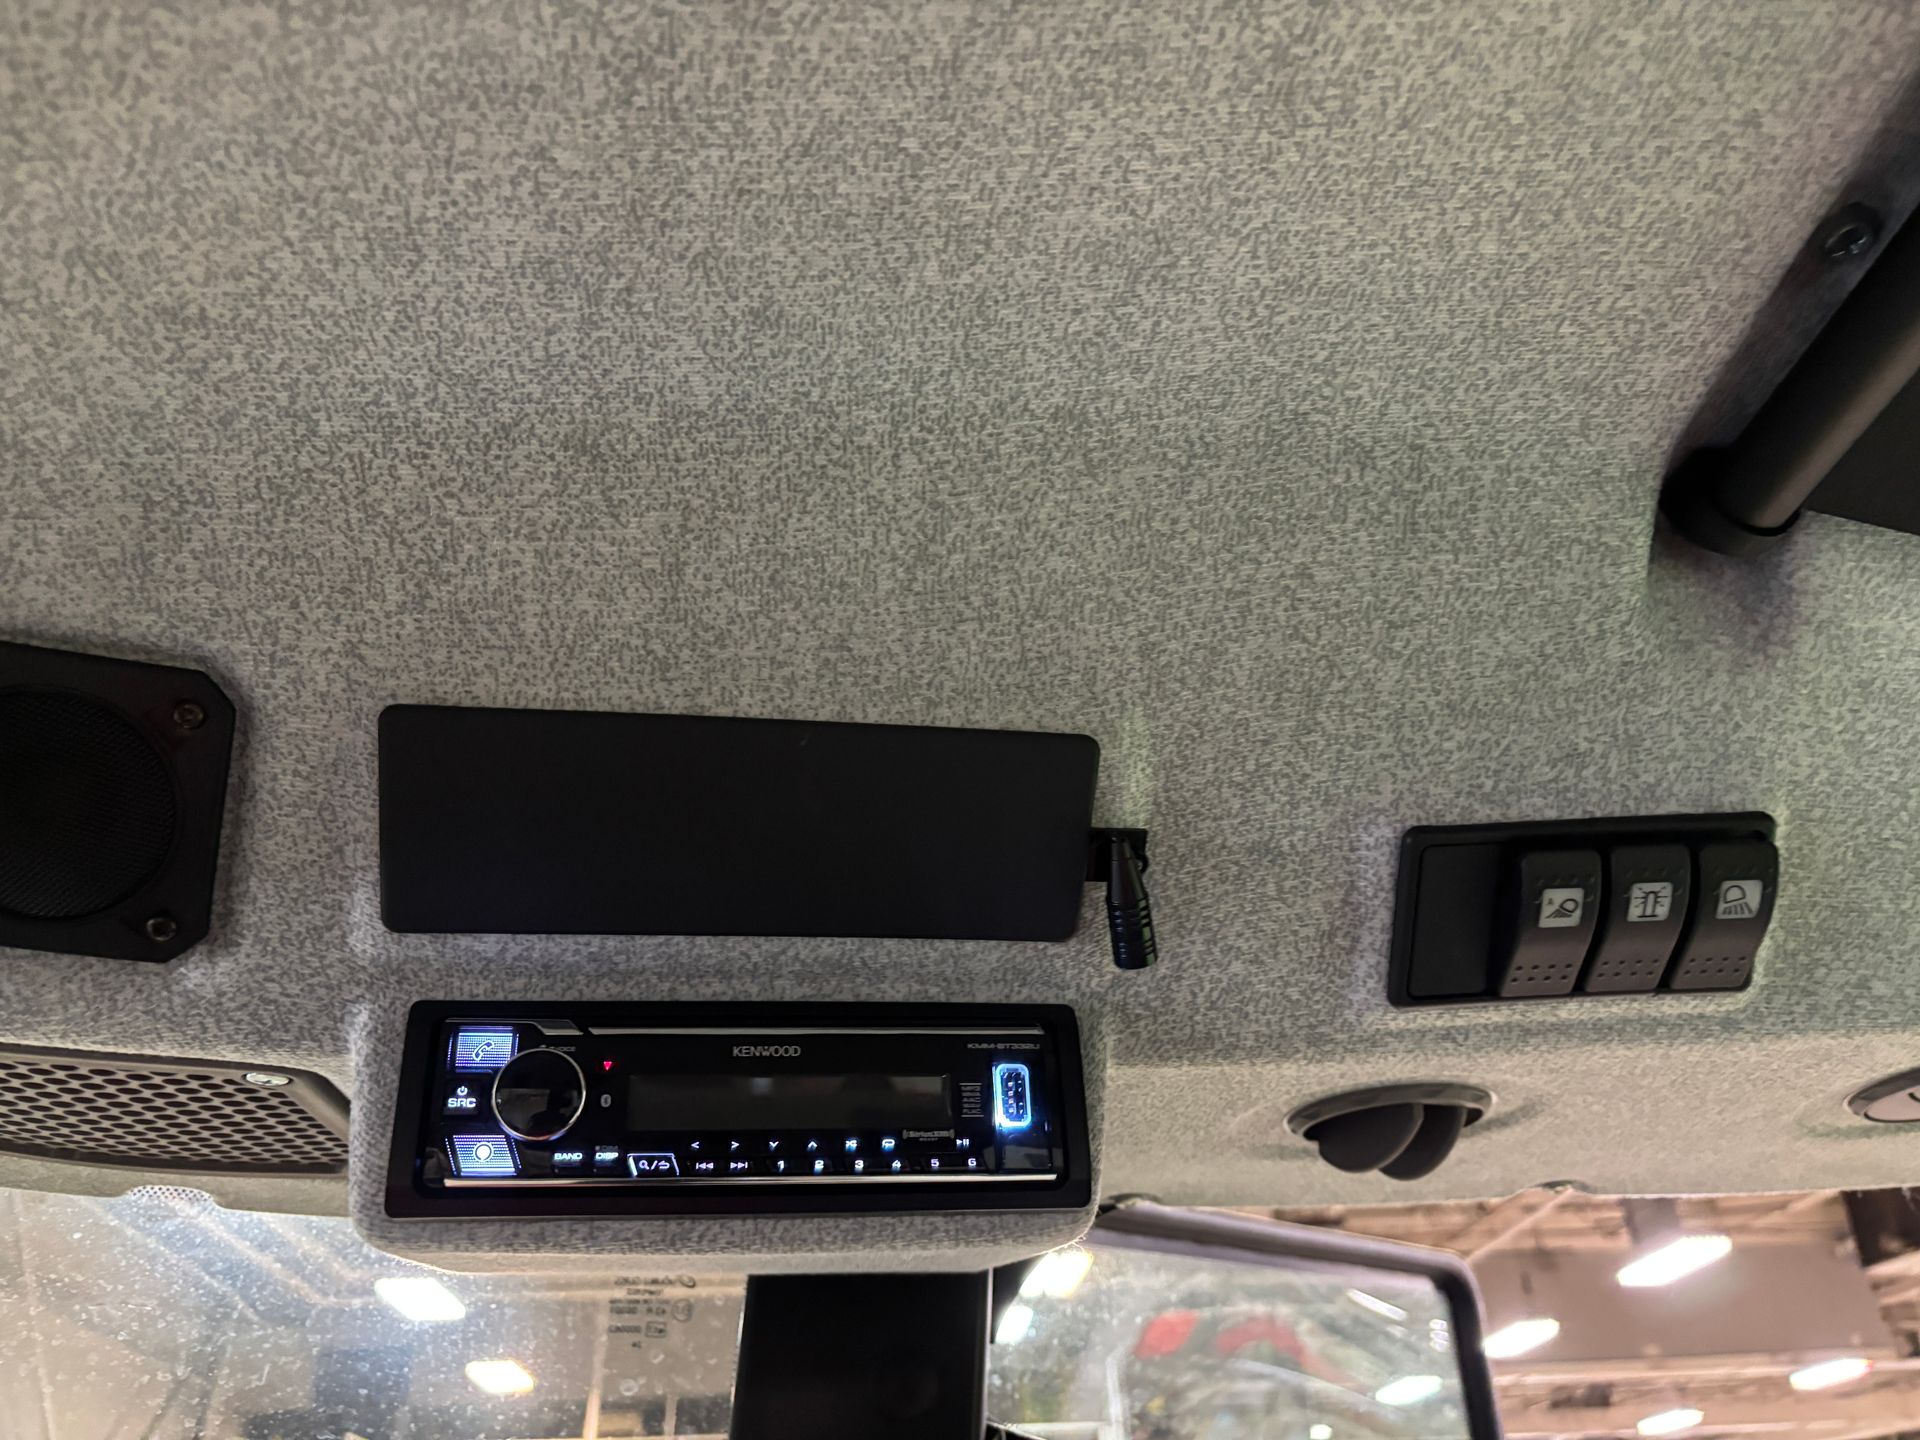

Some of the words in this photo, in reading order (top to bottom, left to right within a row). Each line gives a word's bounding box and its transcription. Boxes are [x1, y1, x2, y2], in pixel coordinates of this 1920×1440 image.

[732, 1045, 802, 1057] KENWOOD
[447, 1097, 477, 1108] SRC
[554, 1152, 583, 1160] BAND
[595, 1152, 619, 1160] DISP
[777, 1160, 785, 1169] 1
[815, 1160, 825, 1169] 2
[855, 1160, 864, 1169] 3
[892, 1160, 901, 1169] 4
[931, 1159, 939, 1167] 5
